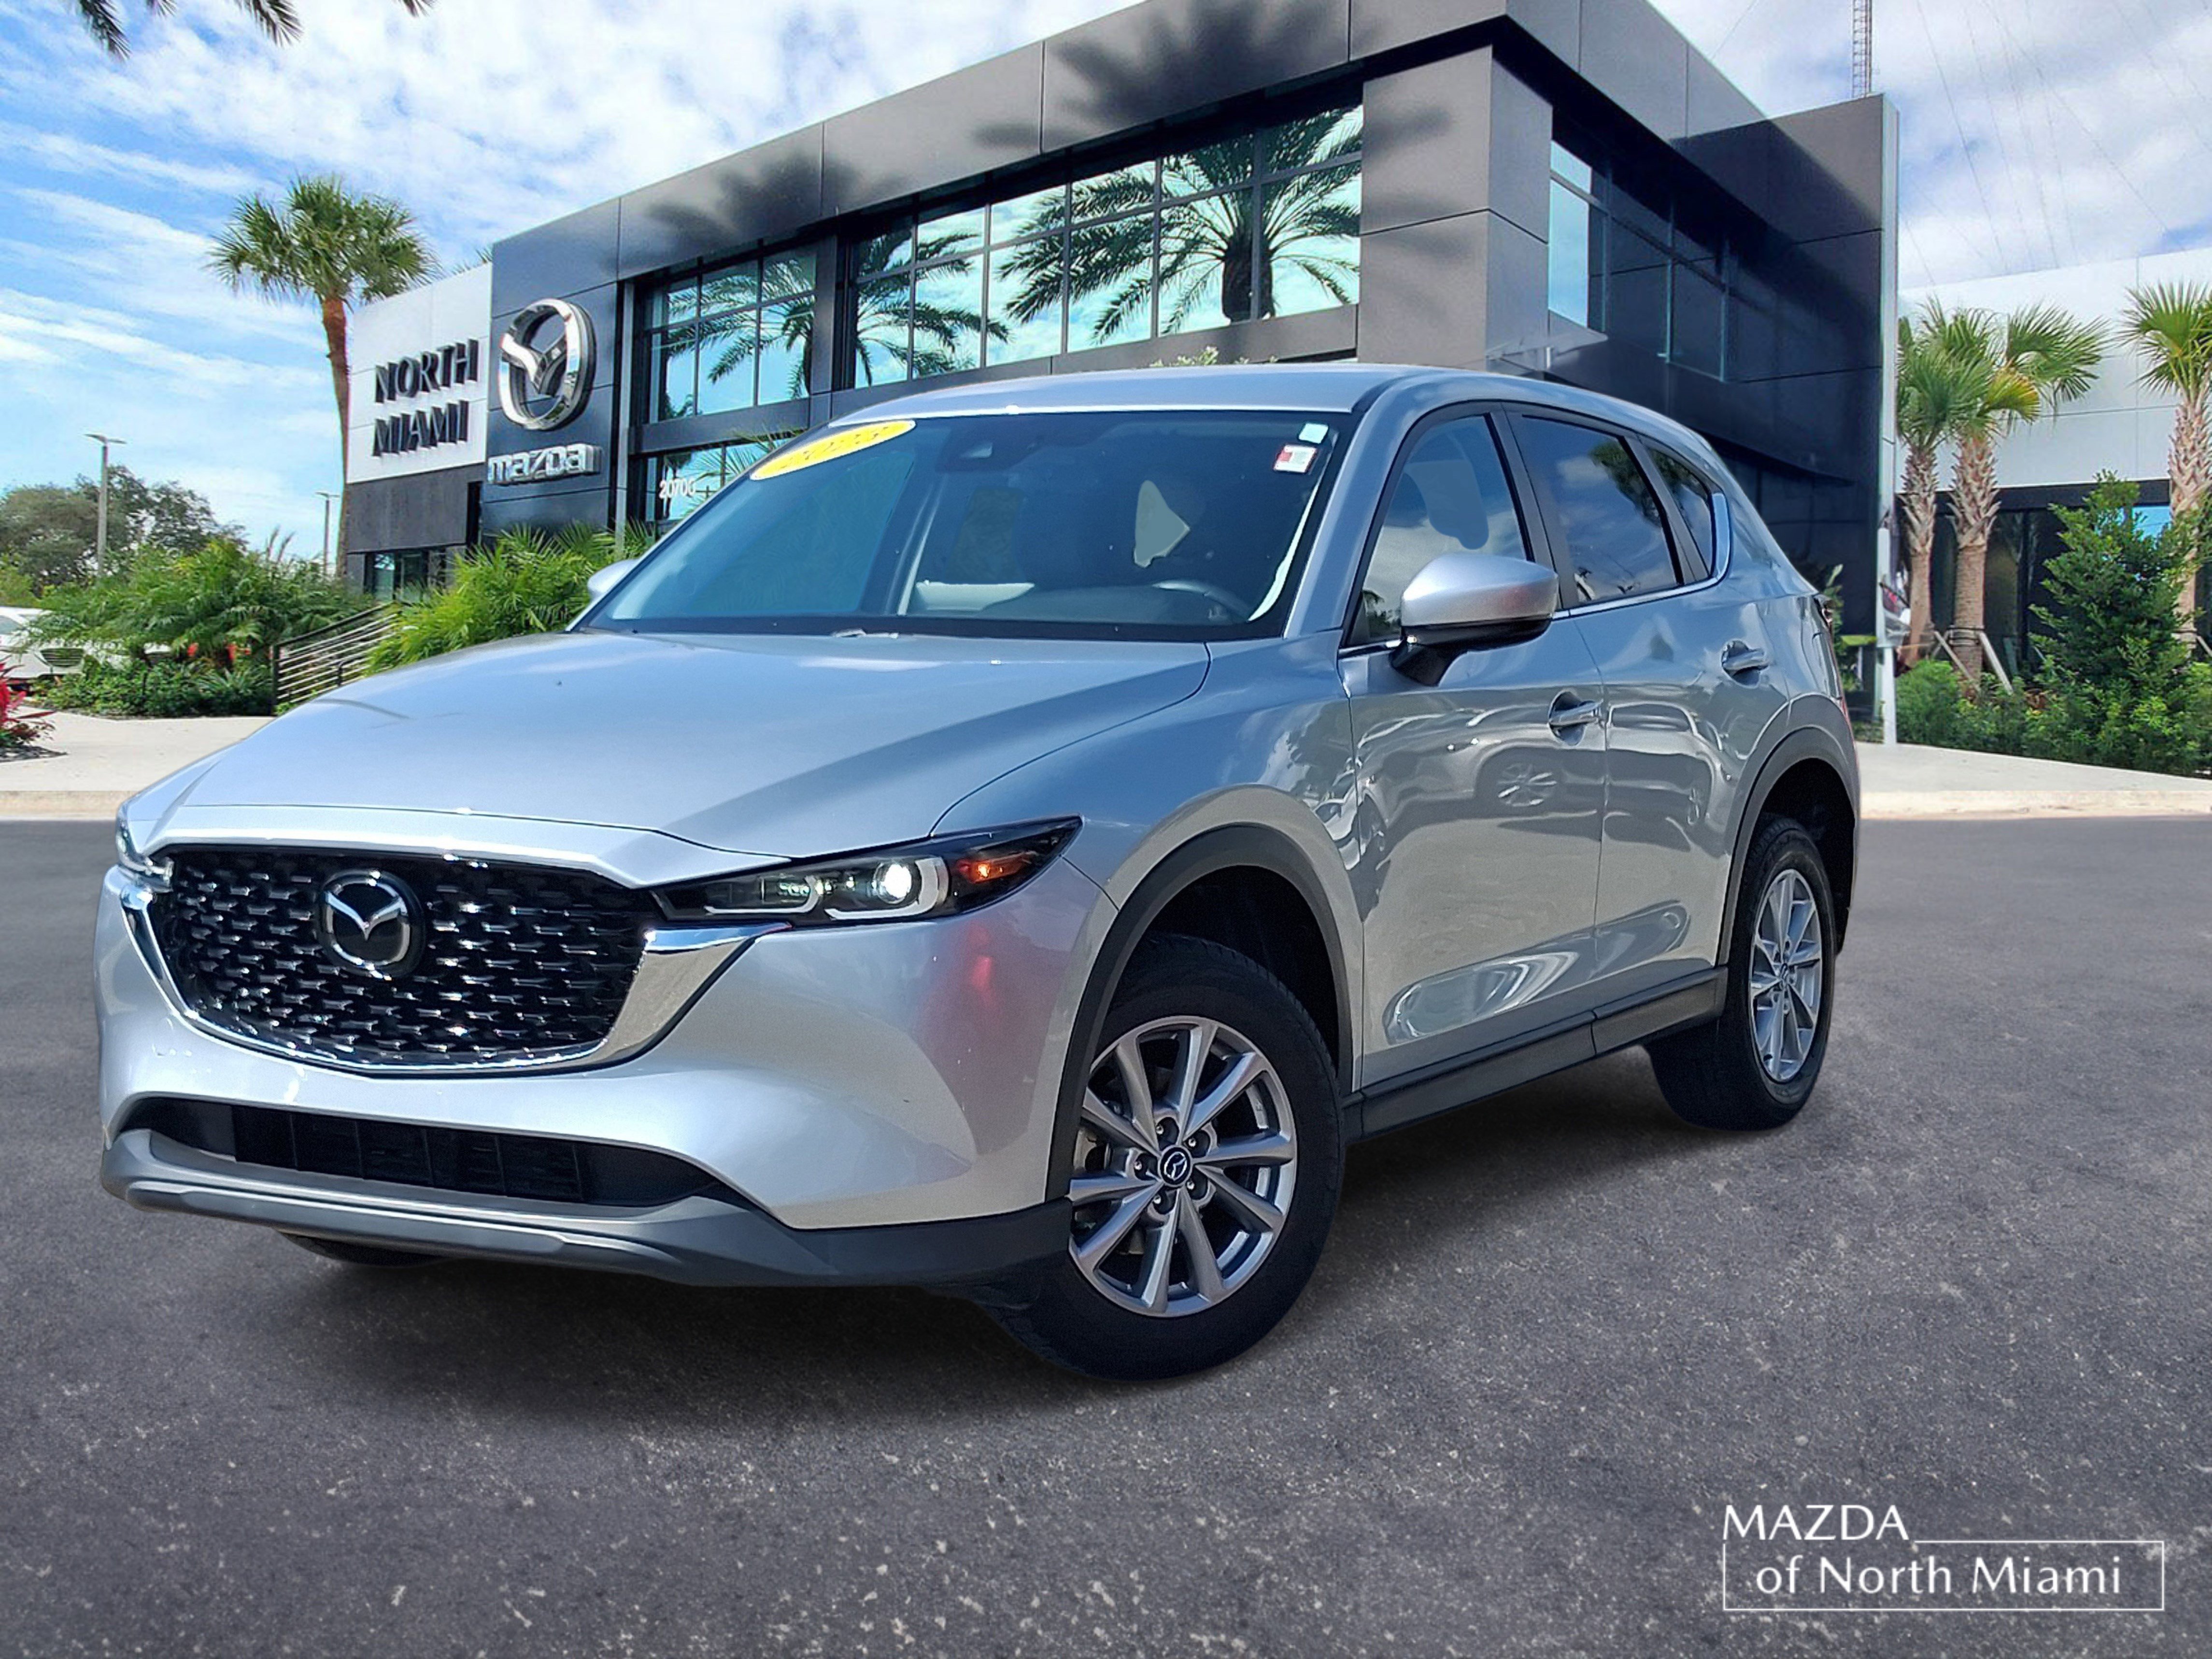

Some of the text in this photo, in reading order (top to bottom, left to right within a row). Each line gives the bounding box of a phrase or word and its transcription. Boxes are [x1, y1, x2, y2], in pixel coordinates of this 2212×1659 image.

[375, 339, 479, 403] NORTH
[372, 400, 469, 457] MIAMI
[659, 478, 696, 499] 20700
